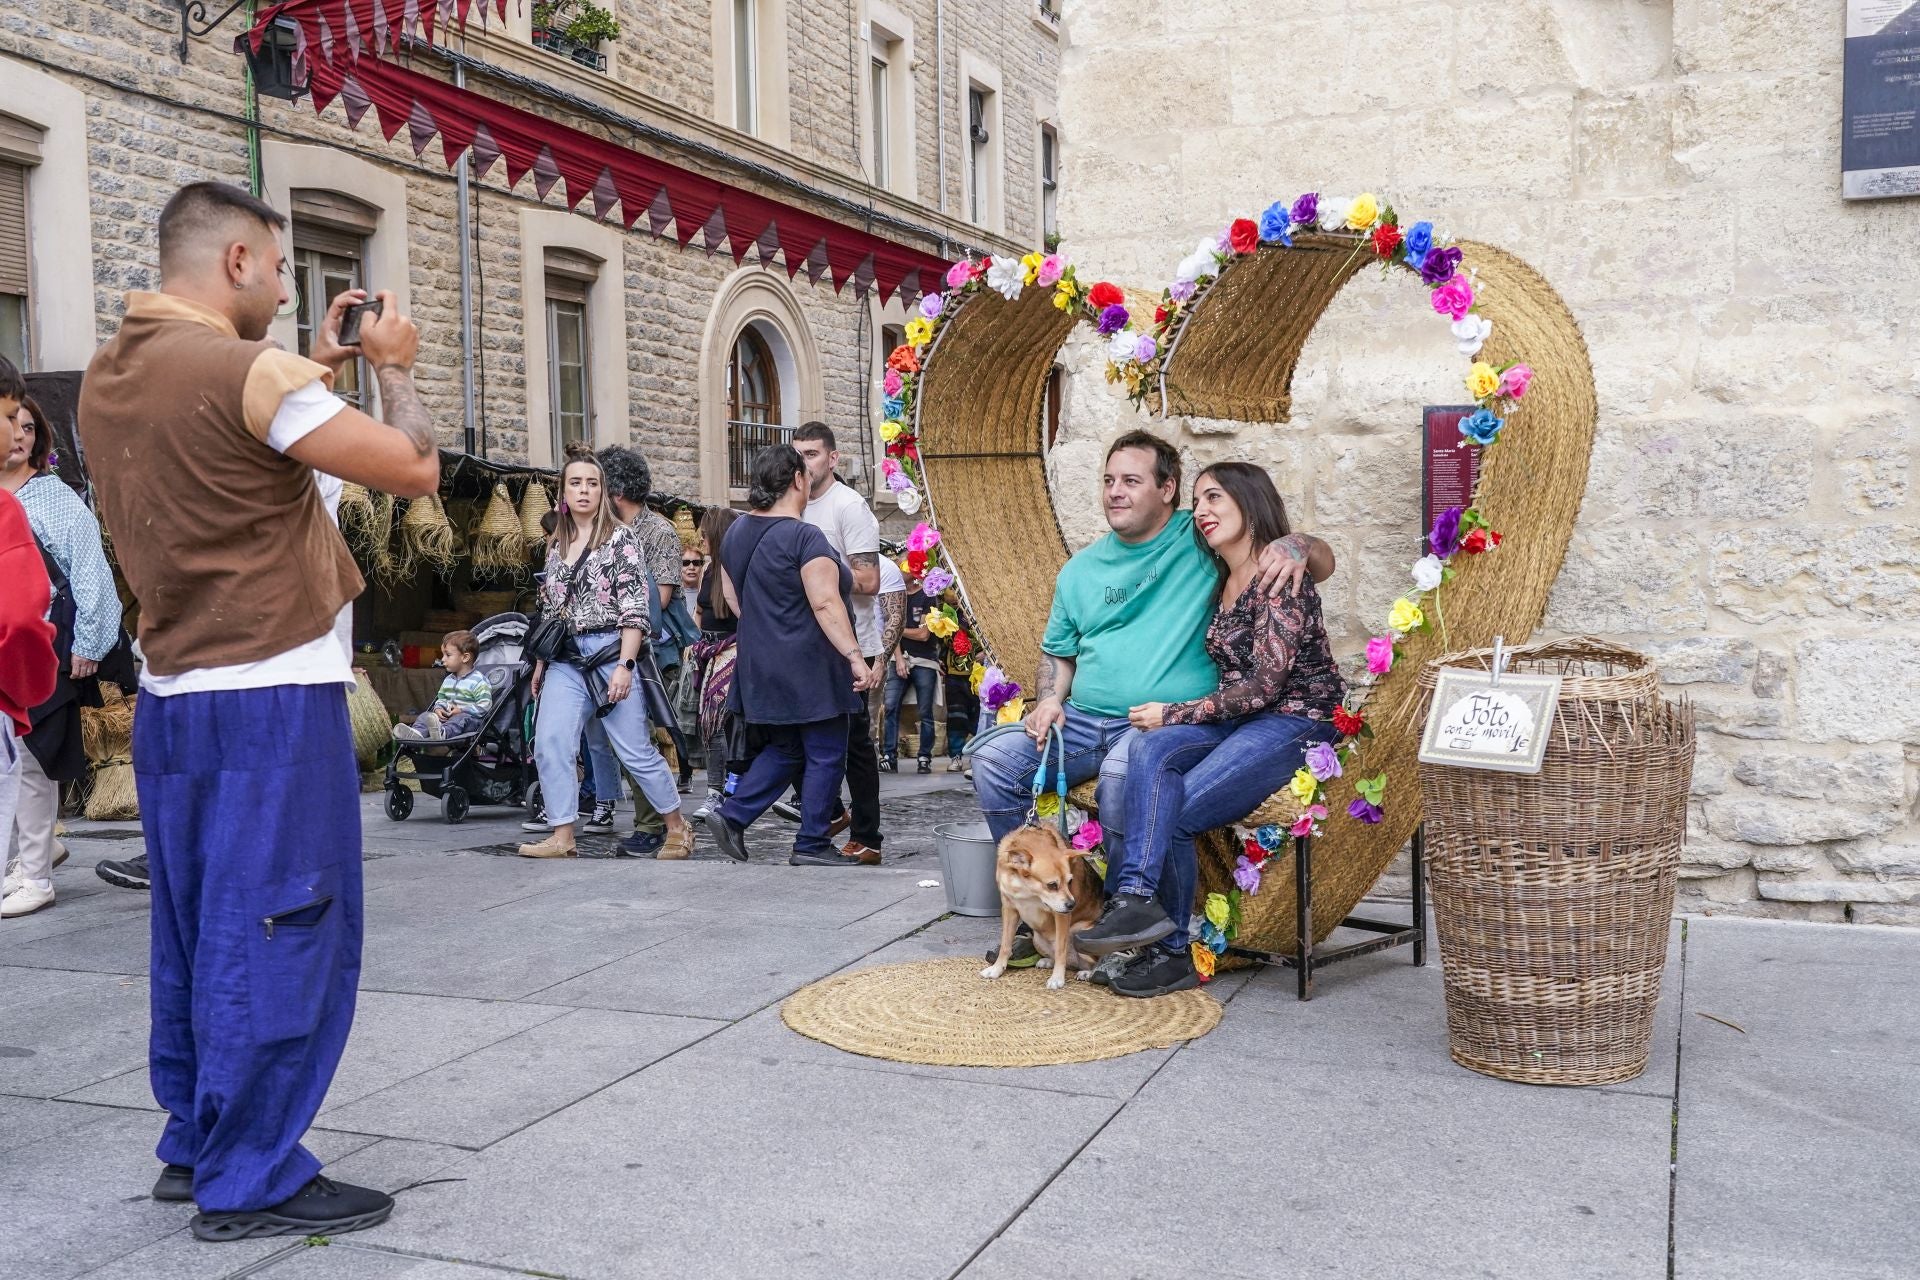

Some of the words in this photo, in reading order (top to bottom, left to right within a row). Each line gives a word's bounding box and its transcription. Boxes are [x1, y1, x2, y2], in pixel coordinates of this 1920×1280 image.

[1462, 694, 1510, 726] Foto
[1444, 725, 1463, 735] con
[1465, 725, 1478, 737] el
